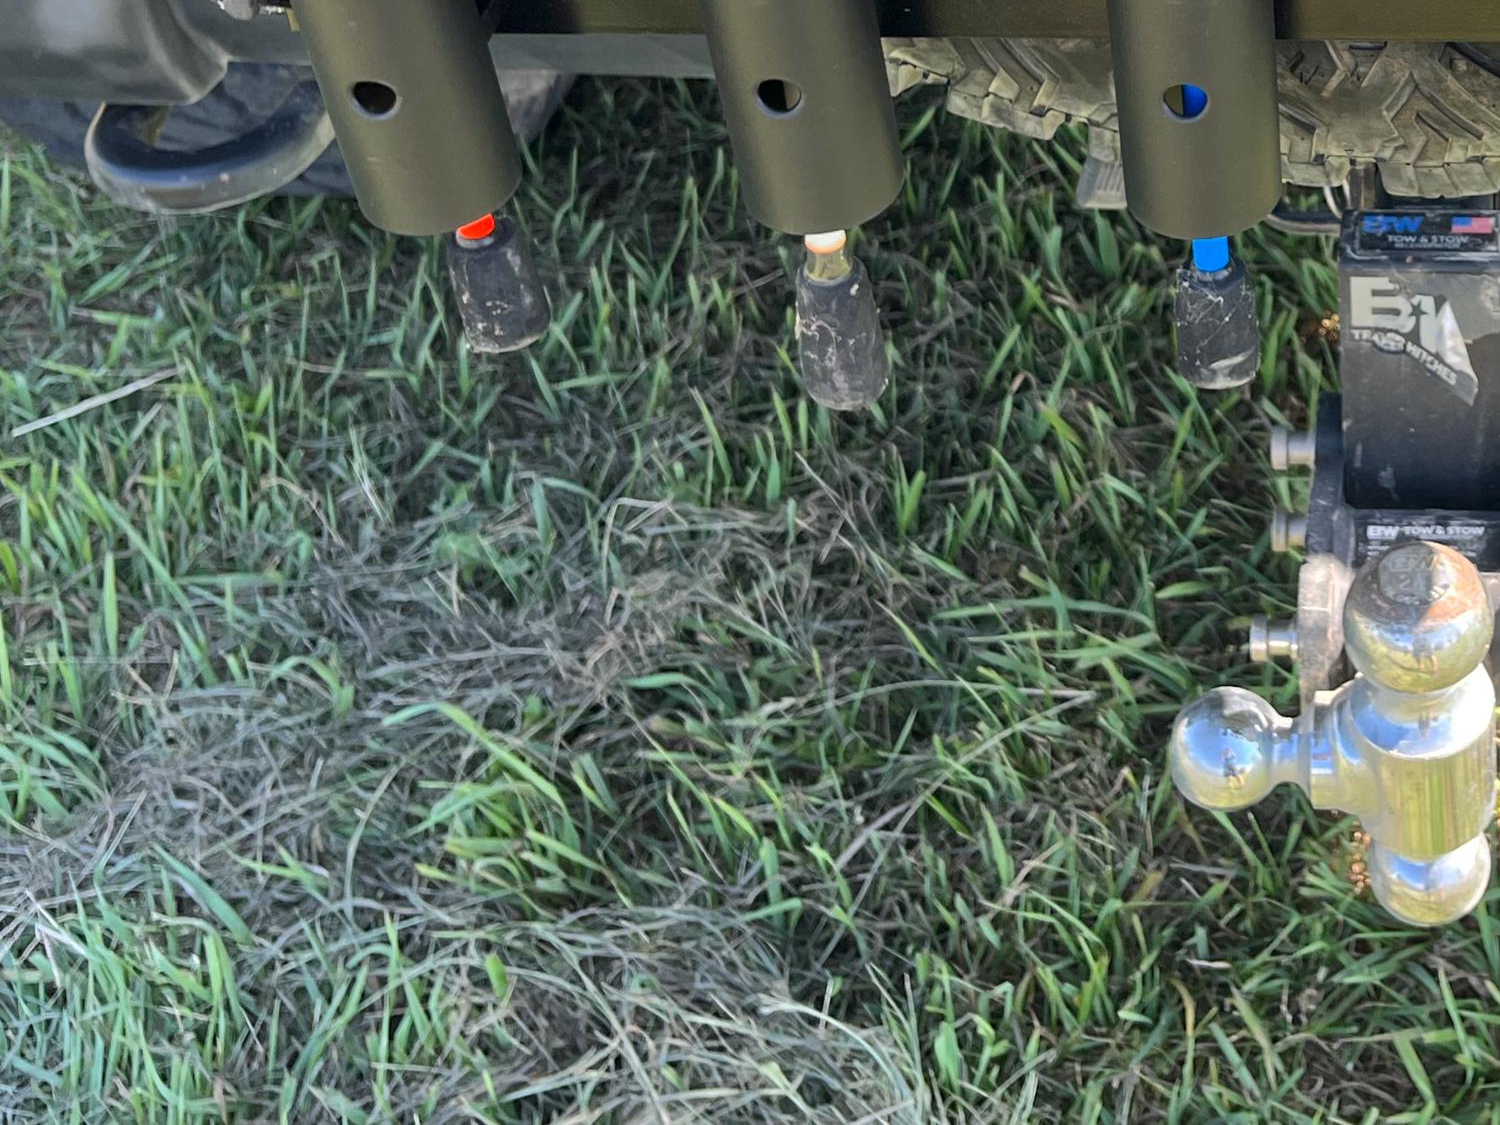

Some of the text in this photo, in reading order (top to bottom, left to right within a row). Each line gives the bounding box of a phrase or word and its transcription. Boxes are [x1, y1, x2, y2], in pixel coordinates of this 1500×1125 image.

[1387, 234, 1417, 243] TOW
[1431, 234, 1469, 244] STOW
[1404, 525, 1435, 536] TOW
[1448, 526, 1485, 536] STOW
